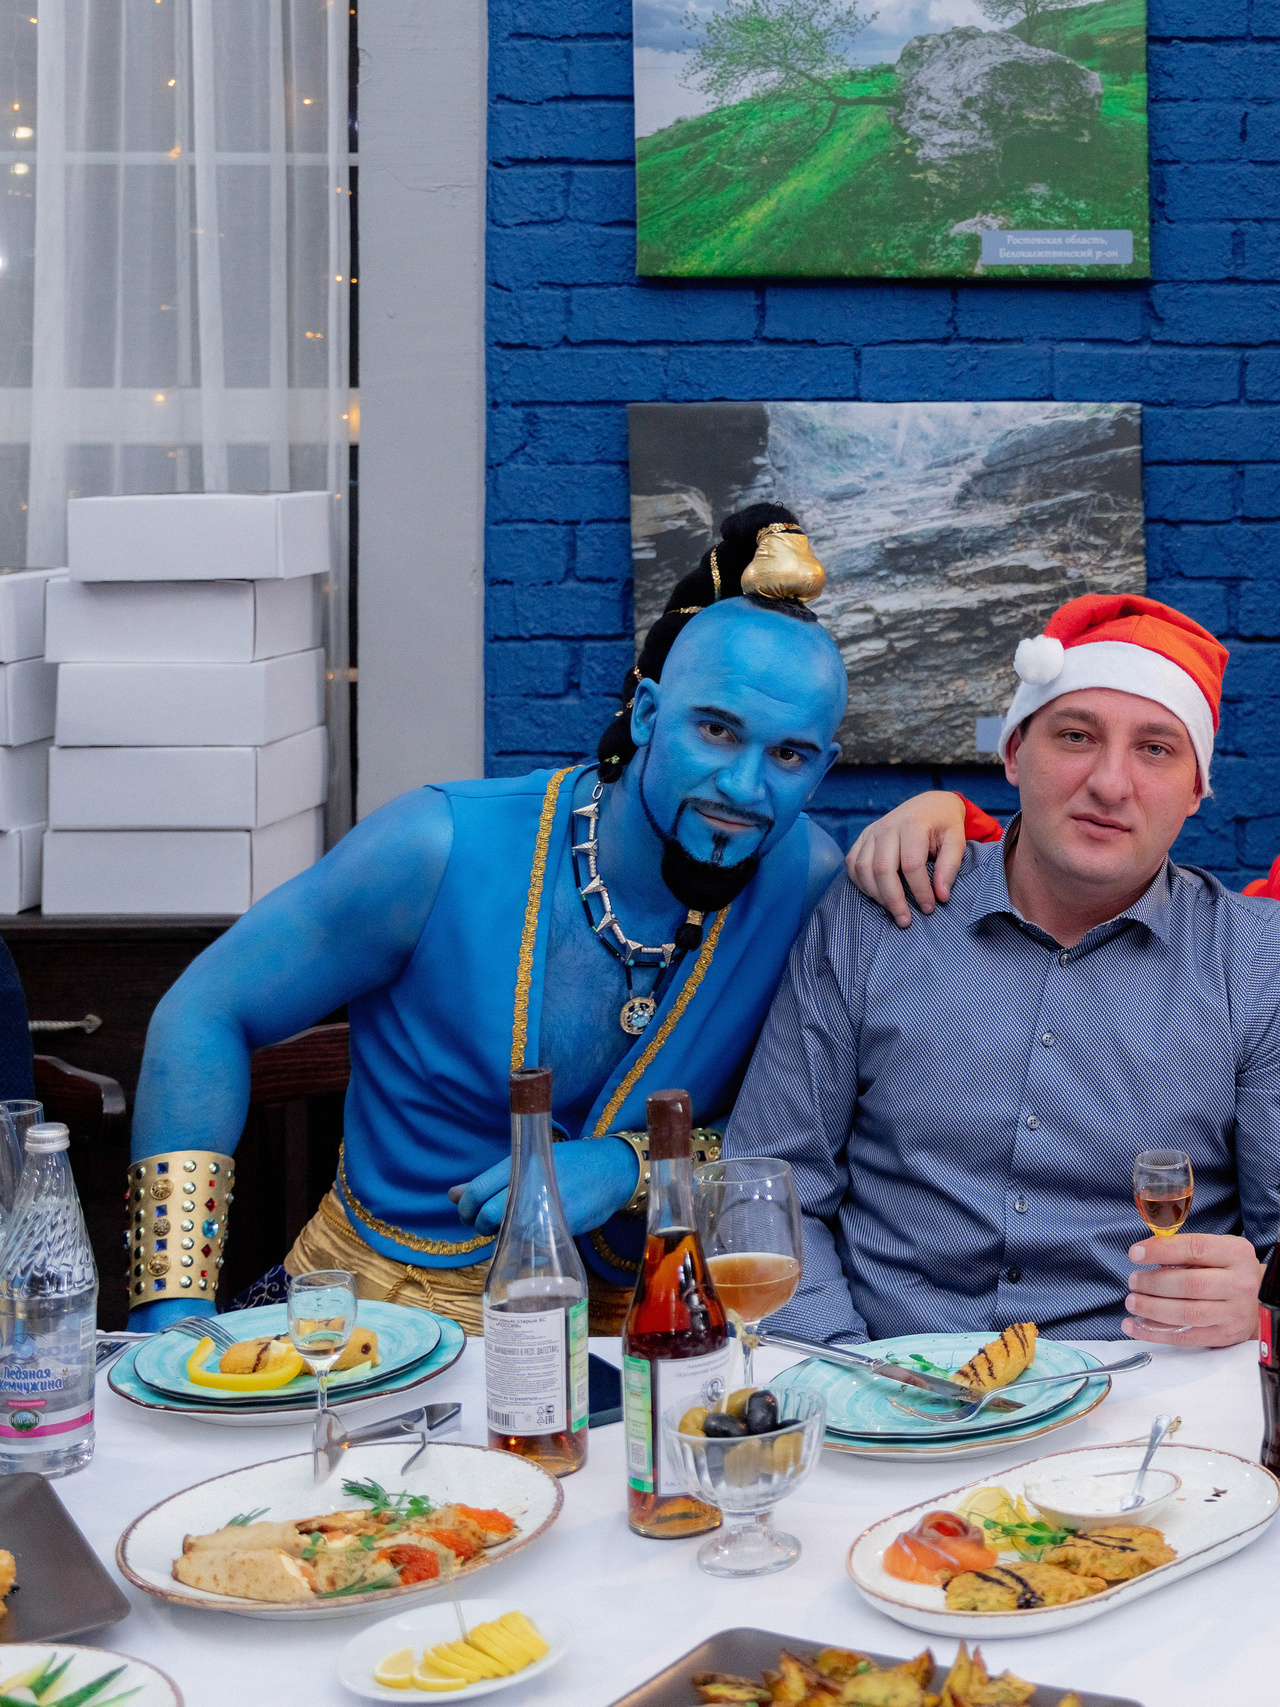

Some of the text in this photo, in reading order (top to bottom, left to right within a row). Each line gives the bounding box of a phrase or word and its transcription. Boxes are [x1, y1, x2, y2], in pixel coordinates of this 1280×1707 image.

[1006, 233, 1108, 245] Ростовская область,
[999, 248, 1093, 258] Белокалитвинский
[3, 1364, 52, 1380] Ледяная
